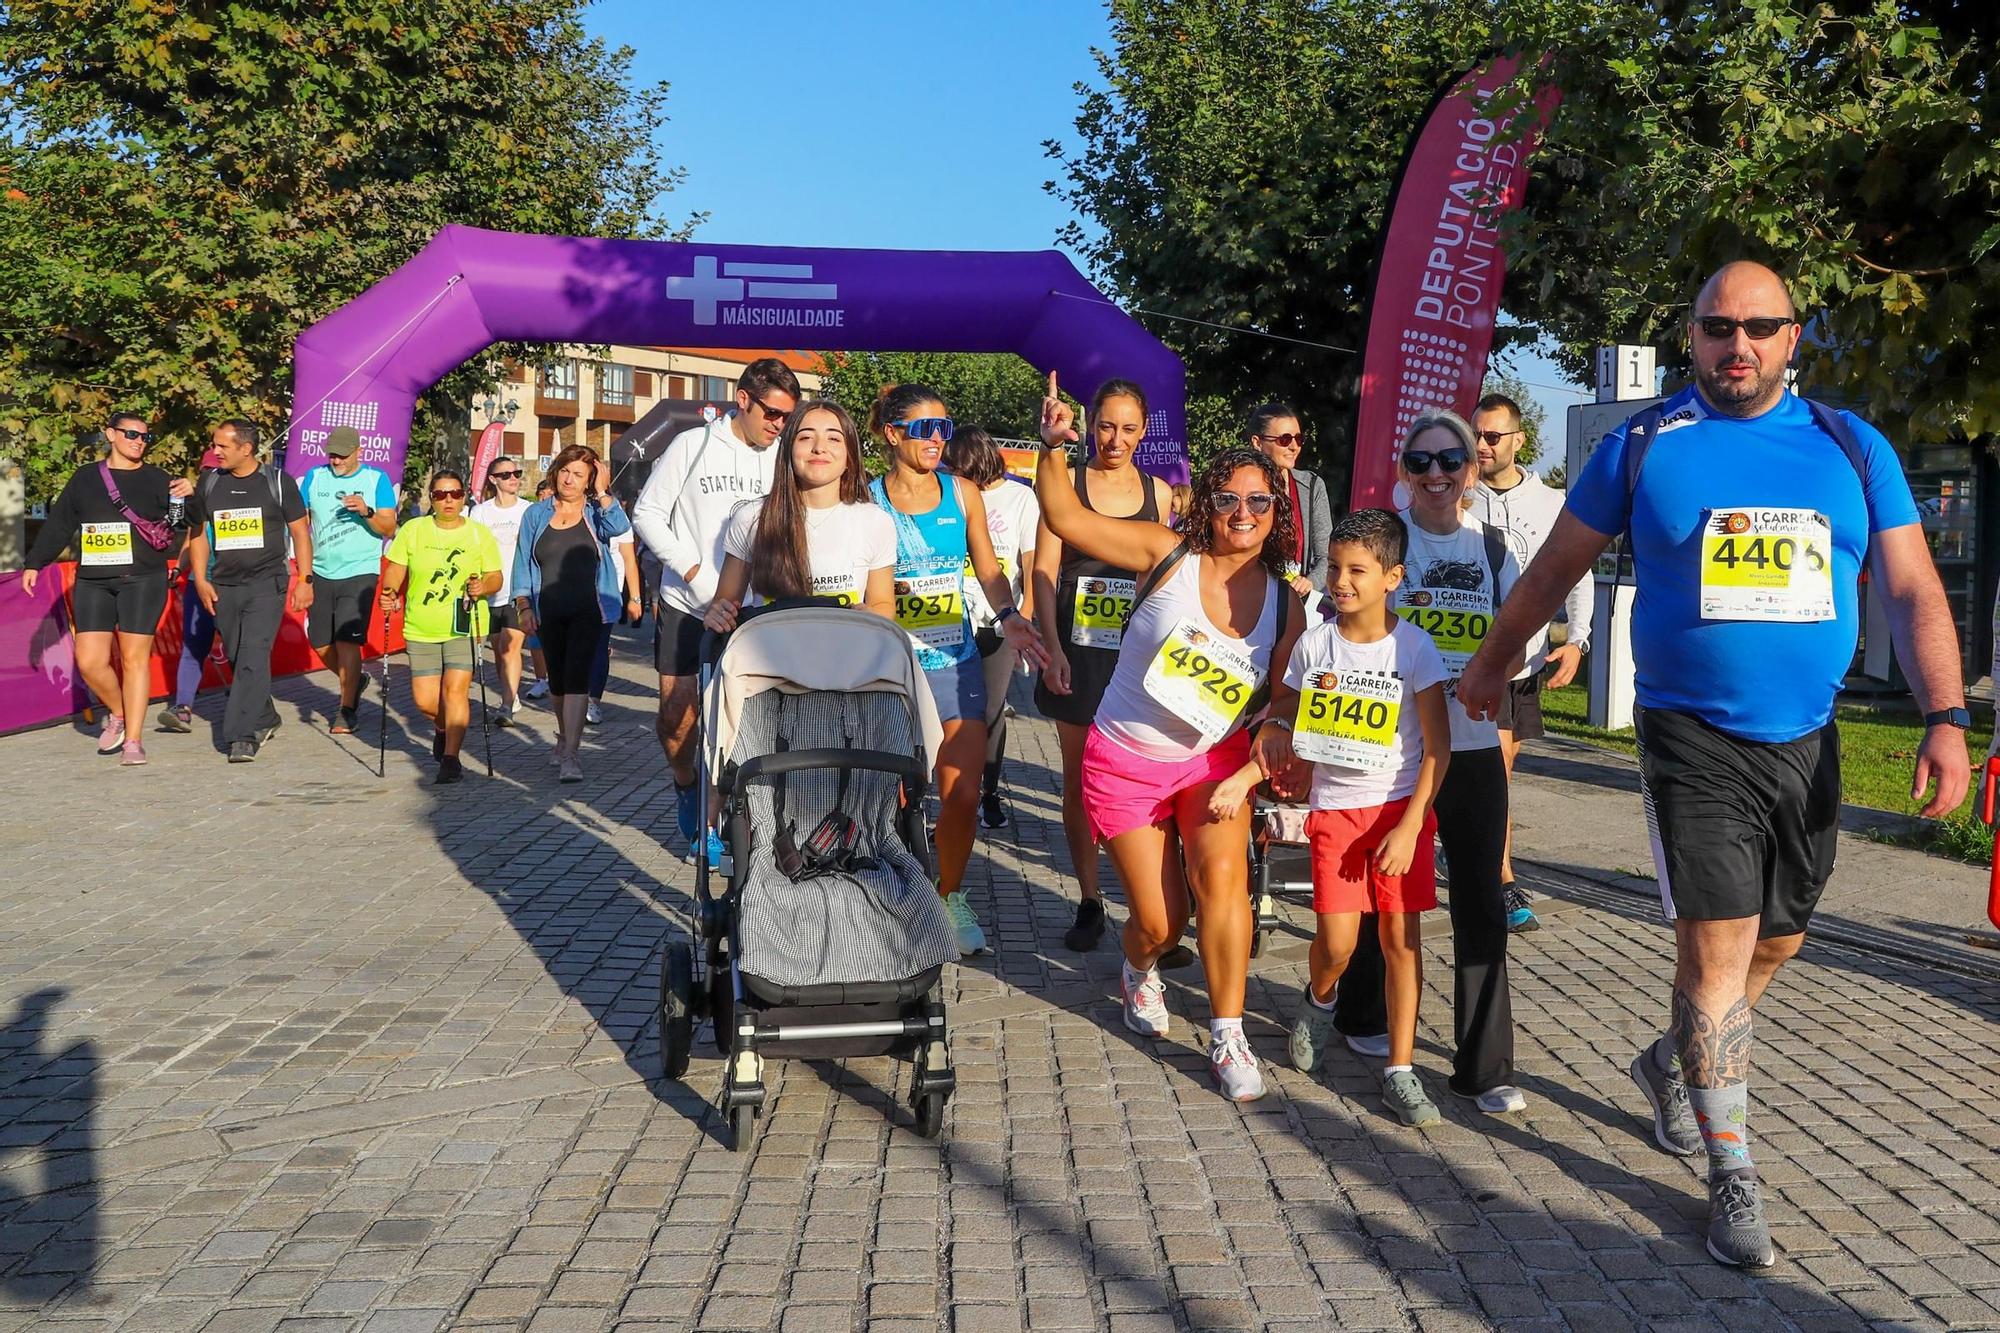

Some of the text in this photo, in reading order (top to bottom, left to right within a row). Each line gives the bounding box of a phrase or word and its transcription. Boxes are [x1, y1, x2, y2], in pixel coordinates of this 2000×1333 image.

[722, 304, 844, 327] MÁISIGUALDADE
[302, 429, 391, 450] DEPCIÓN
[1134, 438, 1181, 454] UTACIÓN
[300, 443, 391, 462] PONEDRA
[1134, 453, 1184, 465] TEVEDRA
[700, 475, 744, 495] STATEN
[218, 519, 260, 532] 4864
[1754, 512, 1758, 522] I
[85, 533, 128, 547] 4865
[894, 560, 963, 574] ESISTENCIA
[917, 576, 956, 588] CARREIRA
[1113, 581, 1136, 591] CARR
[1435, 590, 1489, 604] I CARREIRA
[895, 593, 954, 619] 4937
[1081, 596, 1132, 619] 503
[1406, 609, 1488, 640] 4230
[1168, 646, 1244, 705] 4926
[1340, 674, 1400, 691] I CARREIRA
[1308, 692, 1389, 730] 5140
